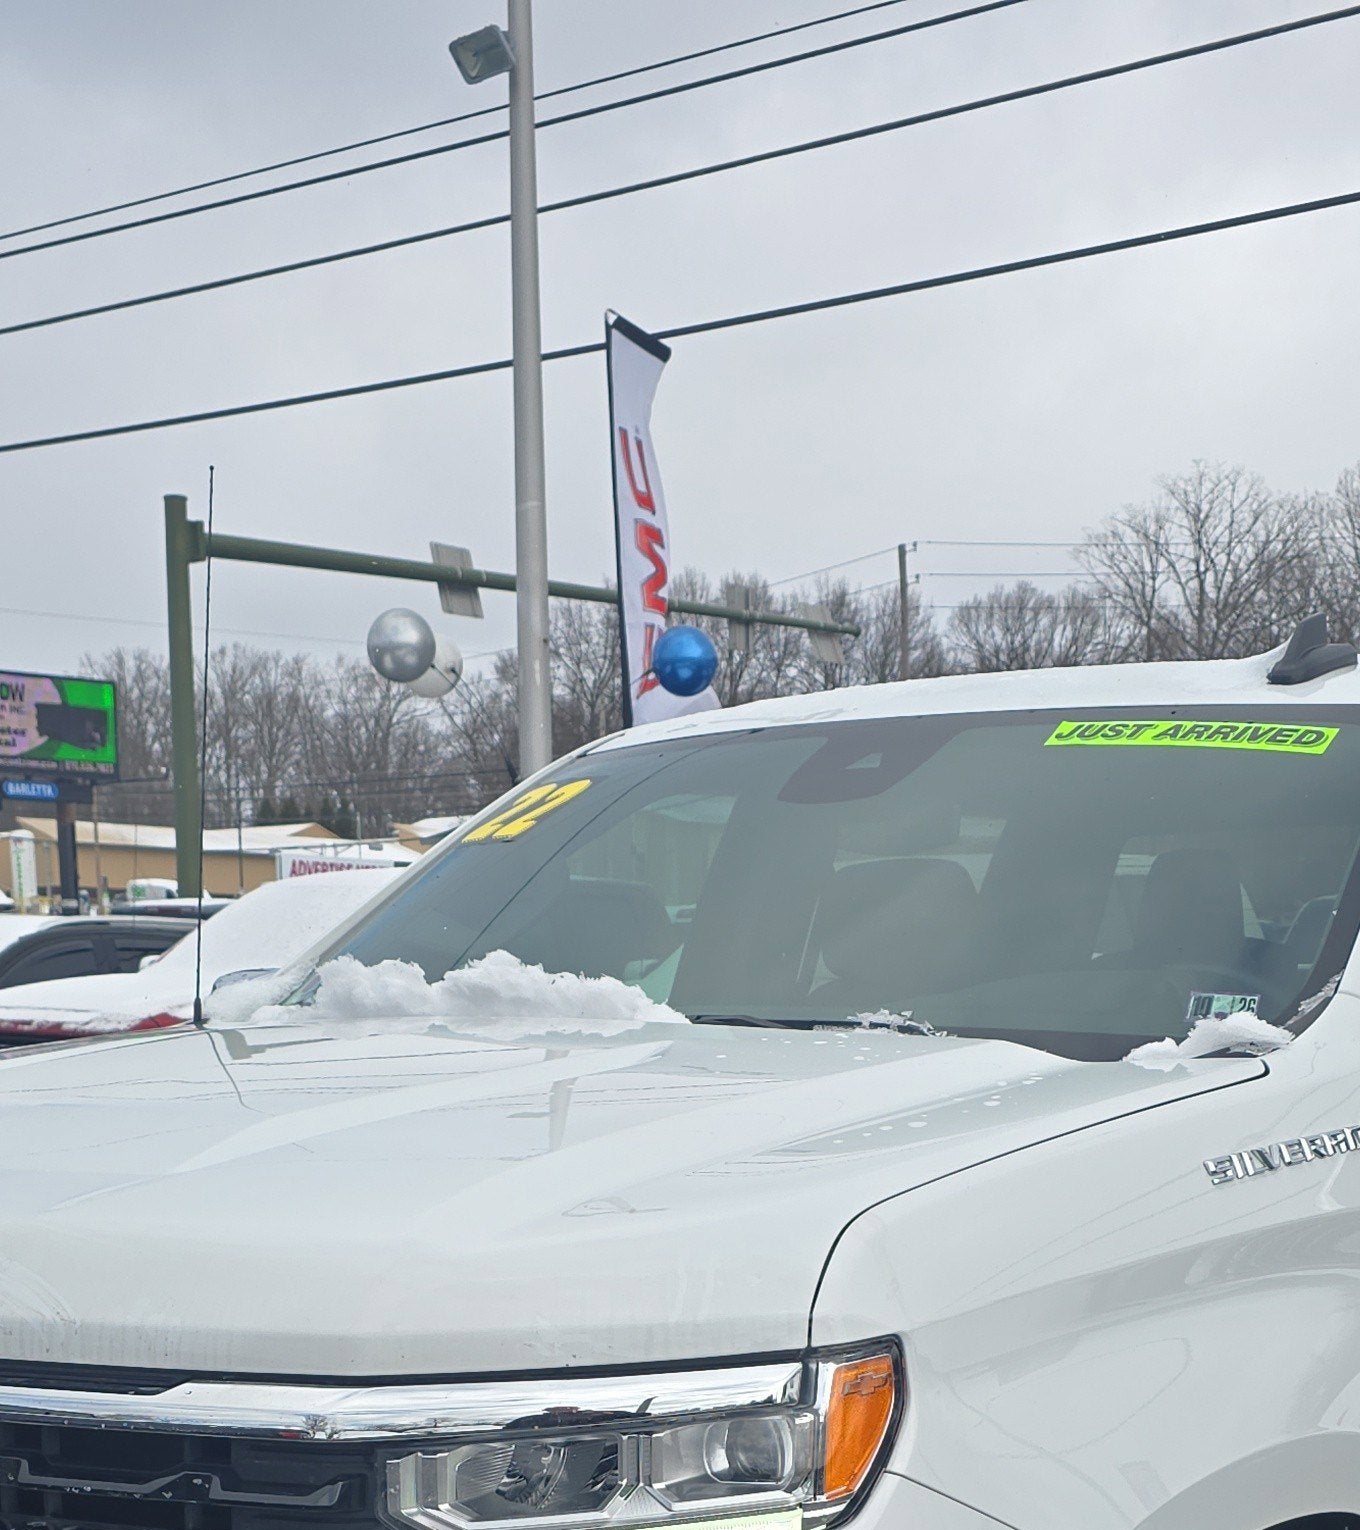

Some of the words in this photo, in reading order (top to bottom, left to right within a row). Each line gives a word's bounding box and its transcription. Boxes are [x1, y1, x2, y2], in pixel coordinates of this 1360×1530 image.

[1055, 722, 1158, 741] JUST
[1152, 722, 1330, 747] ARRIVED
[462, 779, 592, 843] 22
